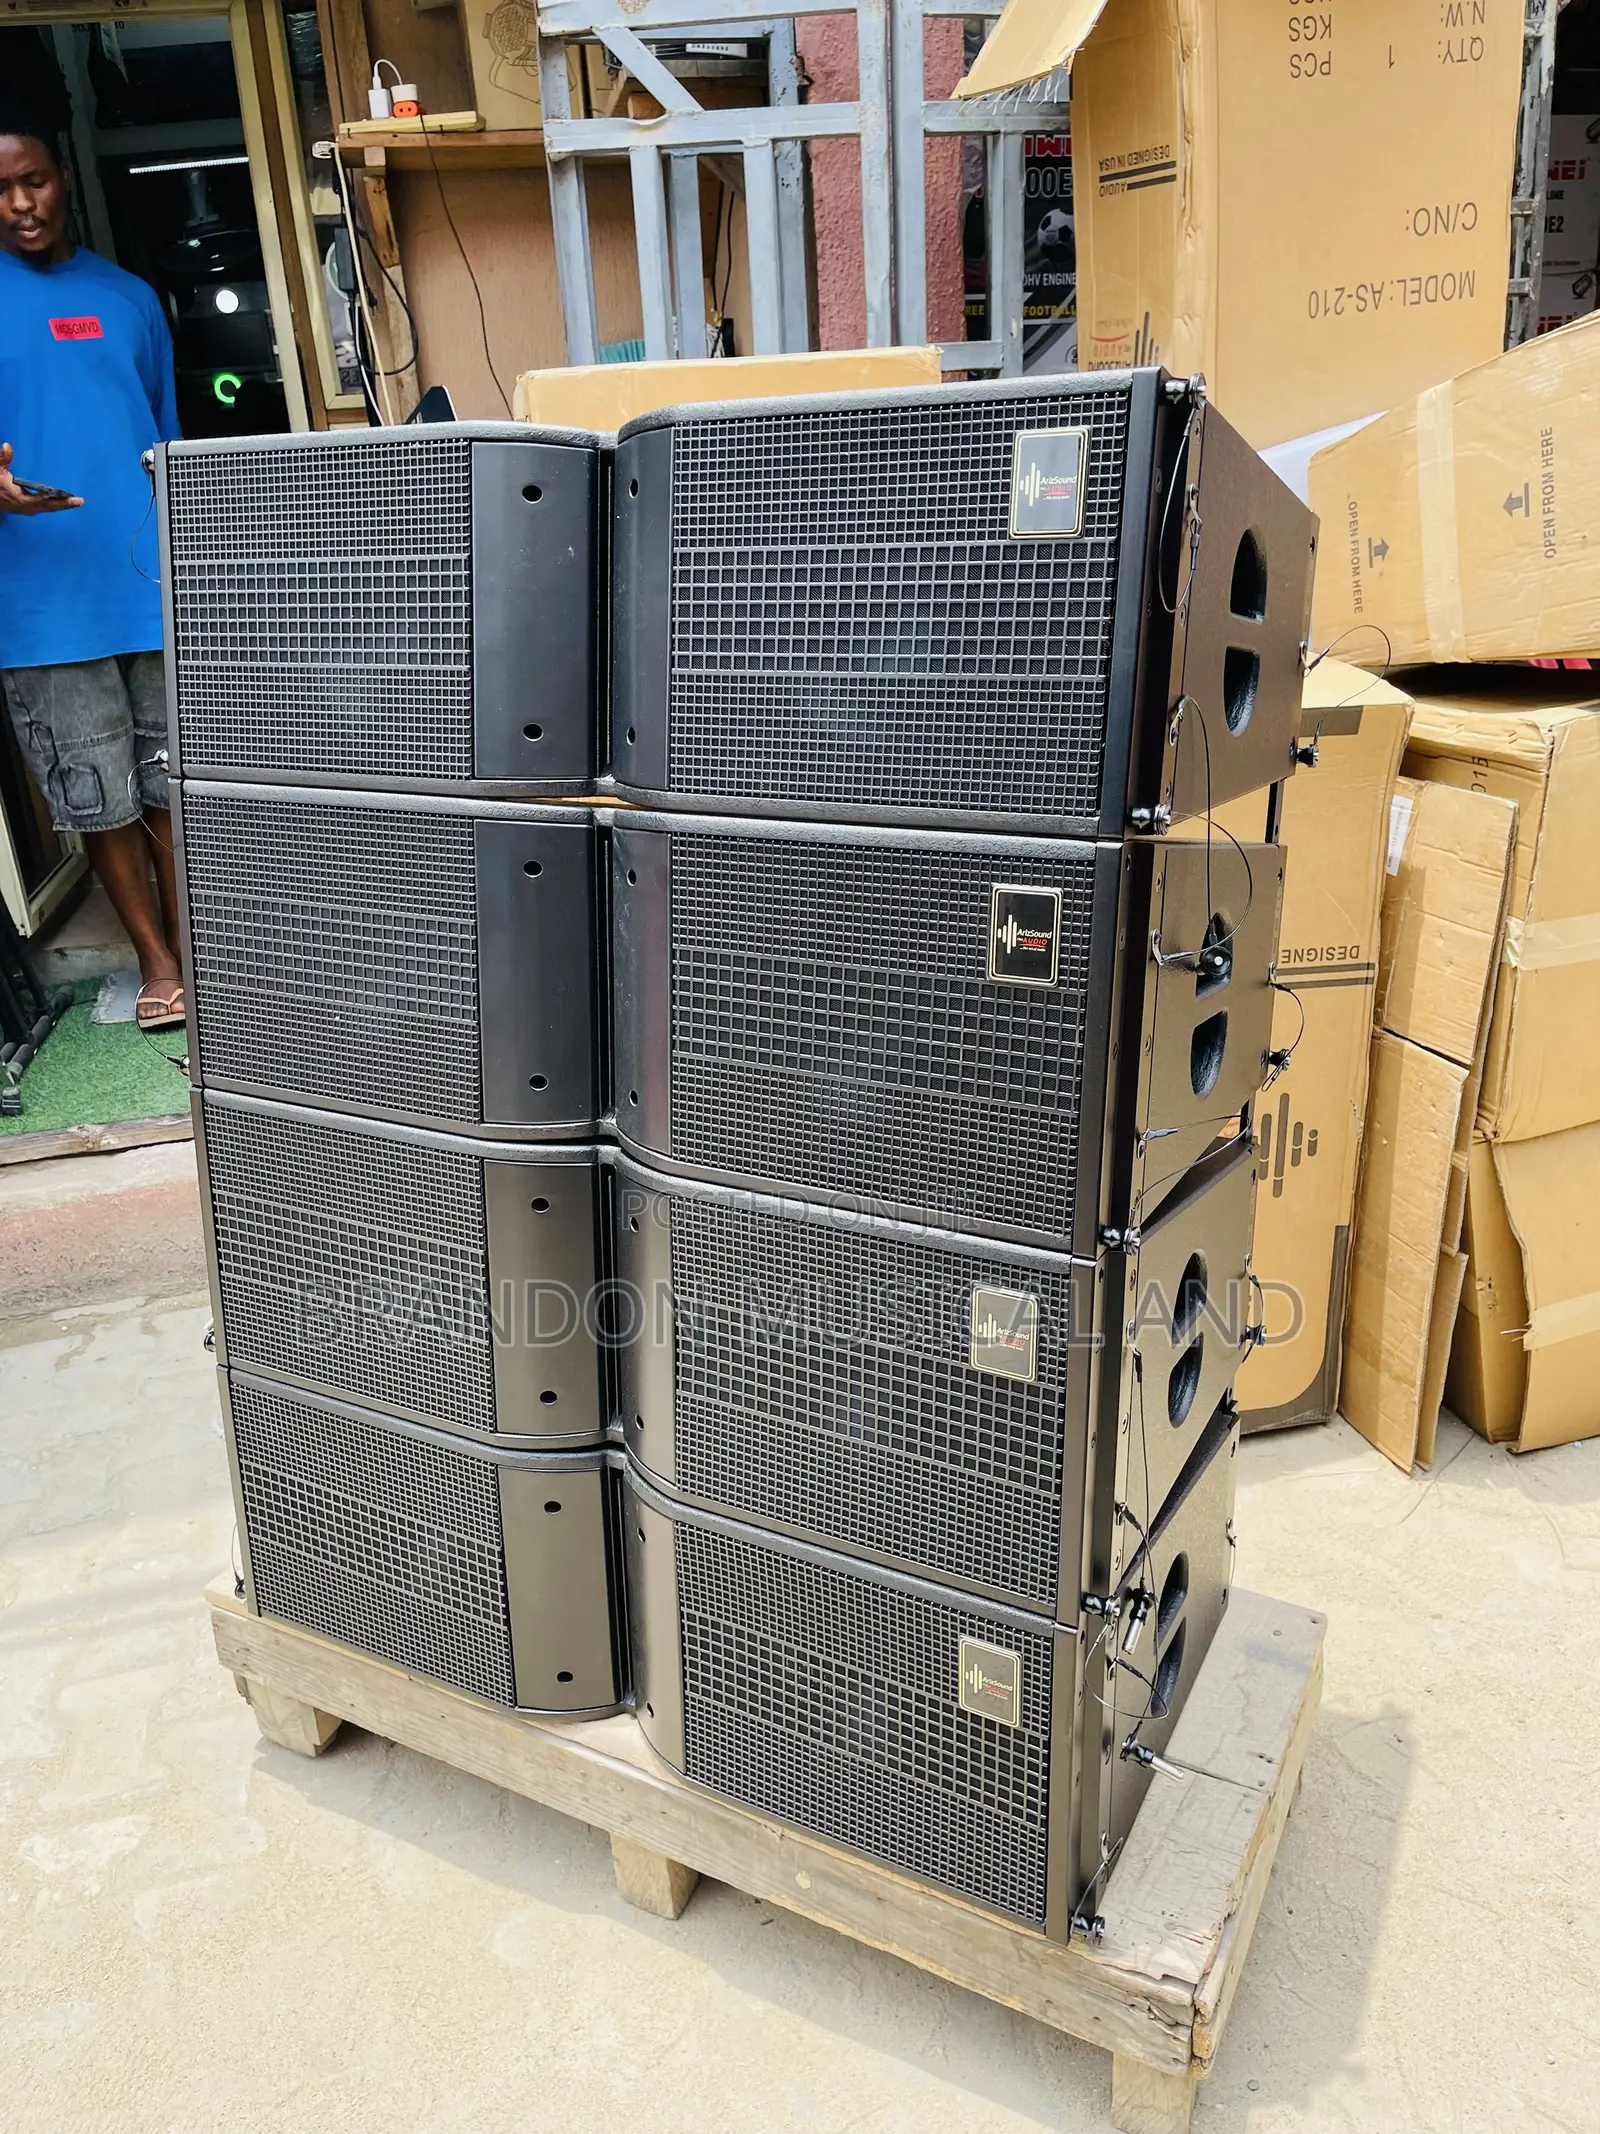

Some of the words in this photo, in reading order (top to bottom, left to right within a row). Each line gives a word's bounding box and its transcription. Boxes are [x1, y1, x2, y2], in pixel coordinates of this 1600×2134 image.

[1288, 14, 1332, 42] KGS
[1388, 45, 1395, 69] 1
[1437, 36, 1485, 65] QTY:
[1289, 51, 1332, 79] PCS
[1099, 157, 1116, 172] USA
[1117, 154, 1126, 168] IN
[1128, 145, 1170, 166] DESIGNED
[1100, 181, 1127, 197] AUDIO
[1405, 201, 1478, 237] C/NO:
[1541, 426, 1554, 468] HERE
[1542, 471, 1555, 515] FROM
[1348, 501, 1359, 537] OPEN
[1543, 518, 1557, 559] OPEN
[1350, 539, 1361, 577] FROM
[1352, 580, 1364, 614] HERE
[1017, 928, 1053, 939] ArizSound
[1022, 937, 1048, 946] AUDIO
[1281, 945, 1360, 964] DESIGNE
